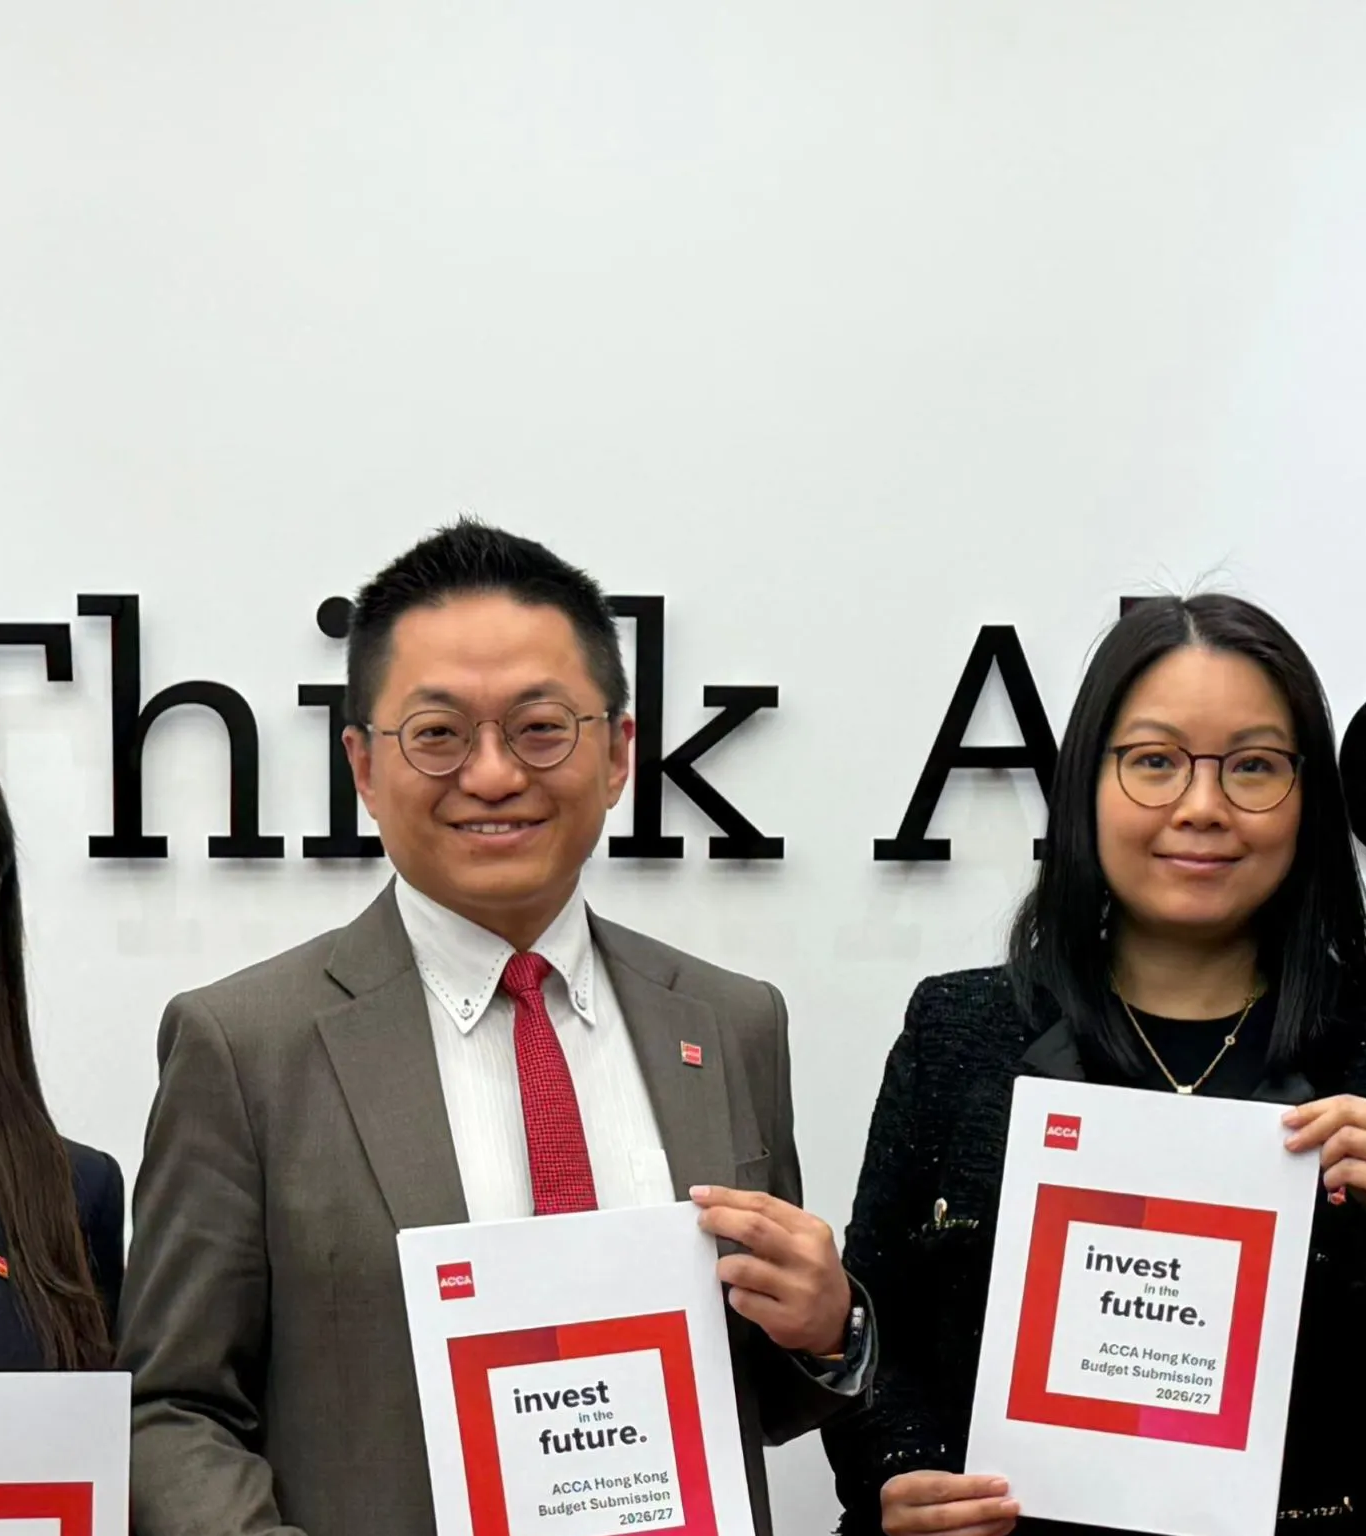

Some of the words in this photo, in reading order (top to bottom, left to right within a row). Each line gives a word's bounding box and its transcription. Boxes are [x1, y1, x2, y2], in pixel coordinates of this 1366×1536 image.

[1046, 1126, 1078, 1138] ACCA
[1085, 1245, 1182, 1282] invest
[440, 1276, 471, 1287] ACCA
[1143, 1283, 1156, 1295] in
[1158, 1286, 1180, 1298] the
[1099, 1289, 1206, 1327] future.
[1098, 1343, 1139, 1359] ACCA
[1141, 1348, 1179, 1367] Hong
[1181, 1353, 1216, 1372] Kong
[1080, 1359, 1129, 1377] Budget
[1133, 1366, 1213, 1387] Submission
[513, 1380, 609, 1413] invest
[1155, 1388, 1212, 1405] 2026/27
[578, 1413, 591, 1424] in
[592, 1411, 614, 1422] the
[538, 1421, 648, 1455] future.
[551, 1480, 593, 1496] ACCA
[594, 1476, 633, 1491] Hong
[633, 1471, 669, 1485] Kong
[538, 1501, 587, 1517] Budget
[590, 1490, 671, 1509] Submission
[618, 1508, 673, 1526] 2026/27
